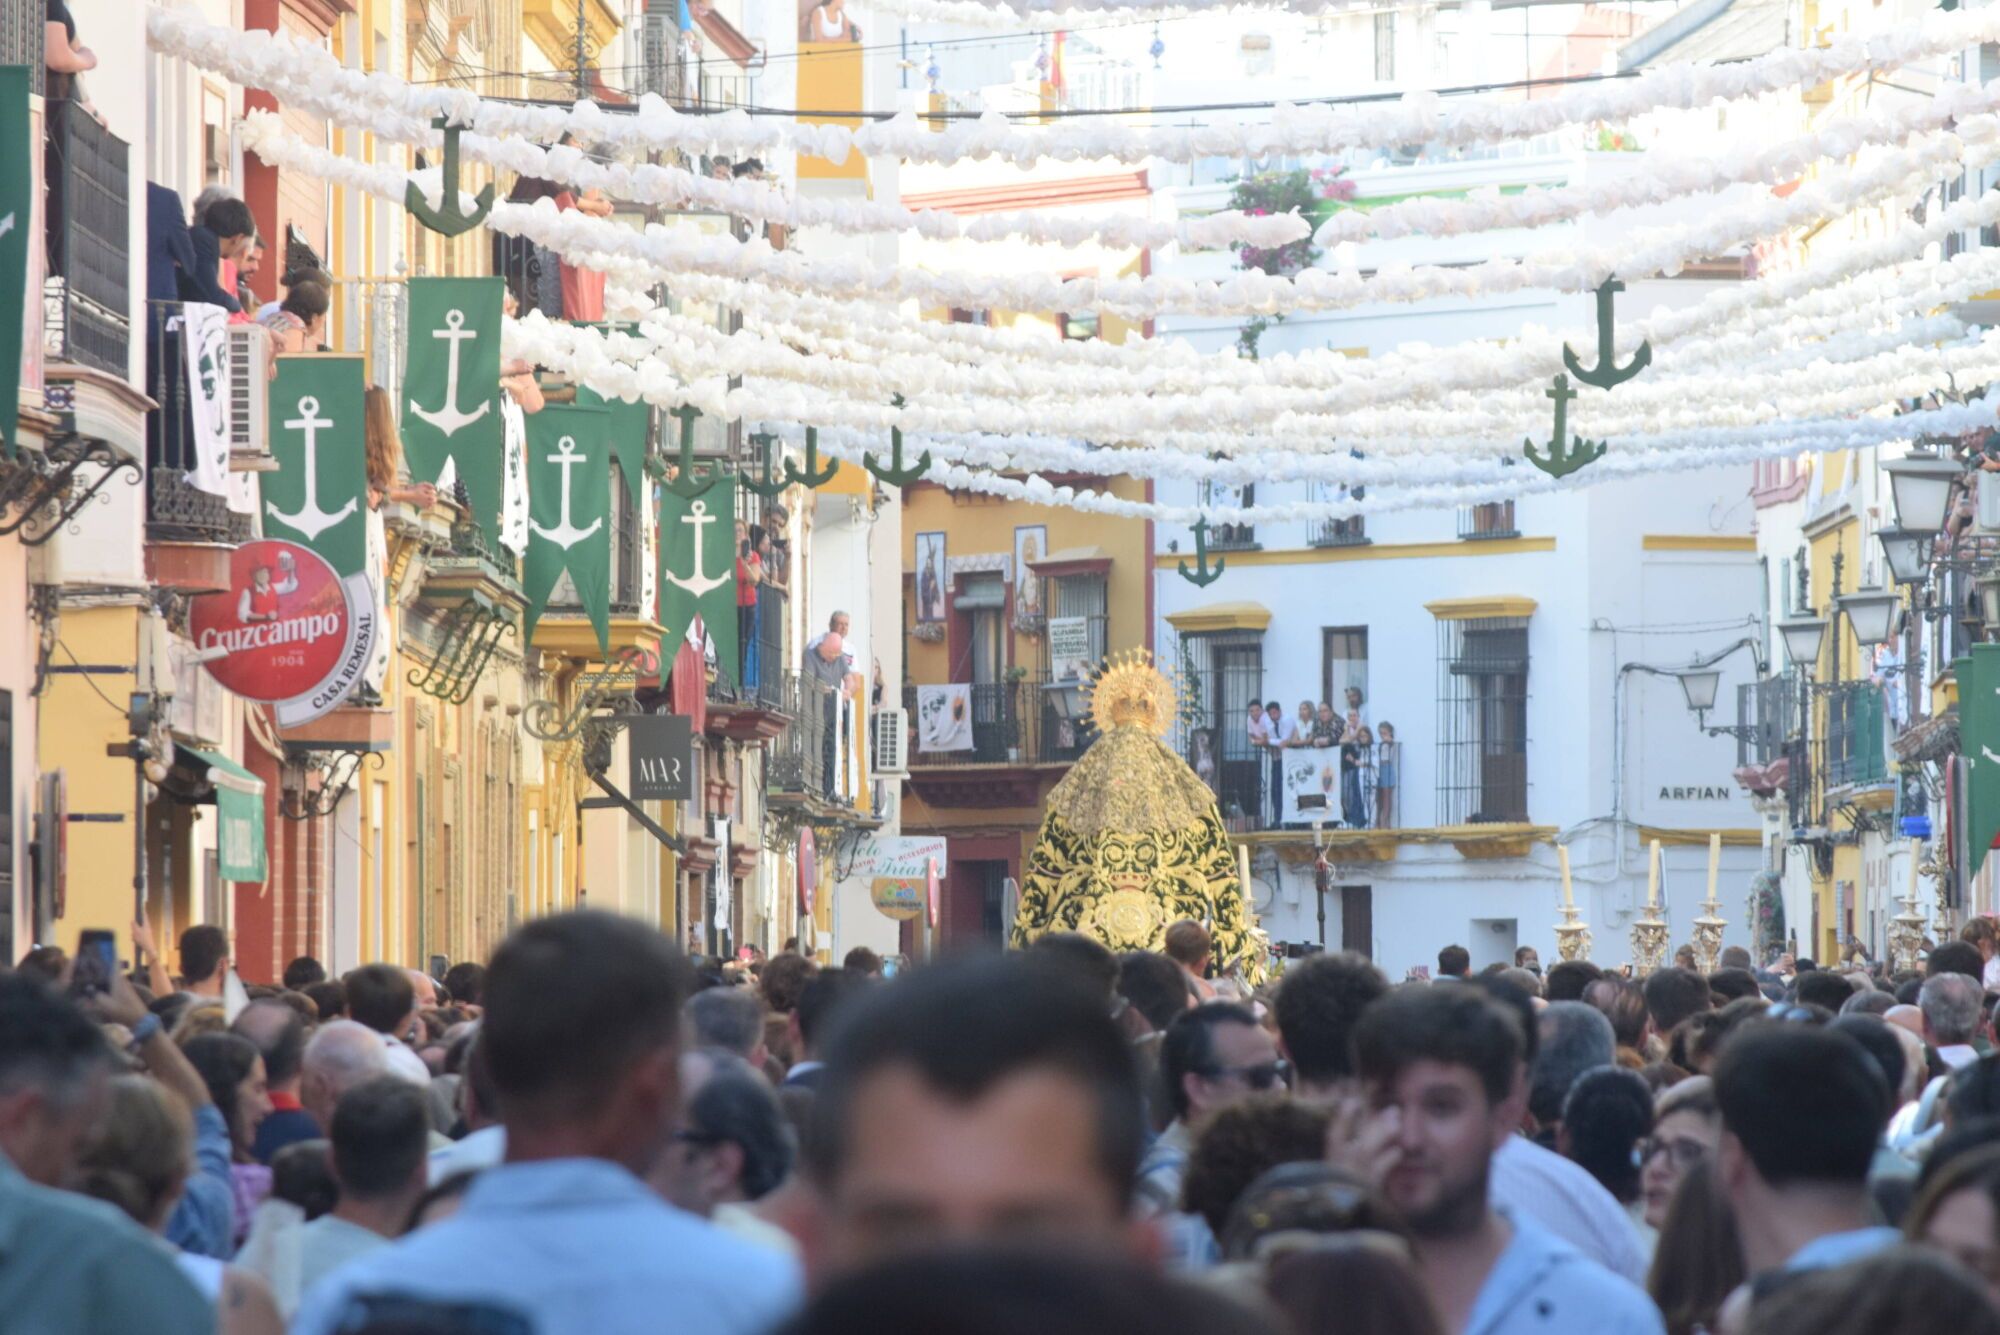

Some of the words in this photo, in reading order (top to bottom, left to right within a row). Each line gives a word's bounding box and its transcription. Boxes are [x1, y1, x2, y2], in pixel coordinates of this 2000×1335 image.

[200, 612, 339, 652] Cruzcampo
[271, 655, 304, 667] 1904
[312, 679, 347, 709] CASA
[342, 613, 372, 680] REMESAL
[640, 757, 681, 782] MAR
[1660, 786, 1729, 800] ARFIAN
[839, 836, 881, 857] Cclo
